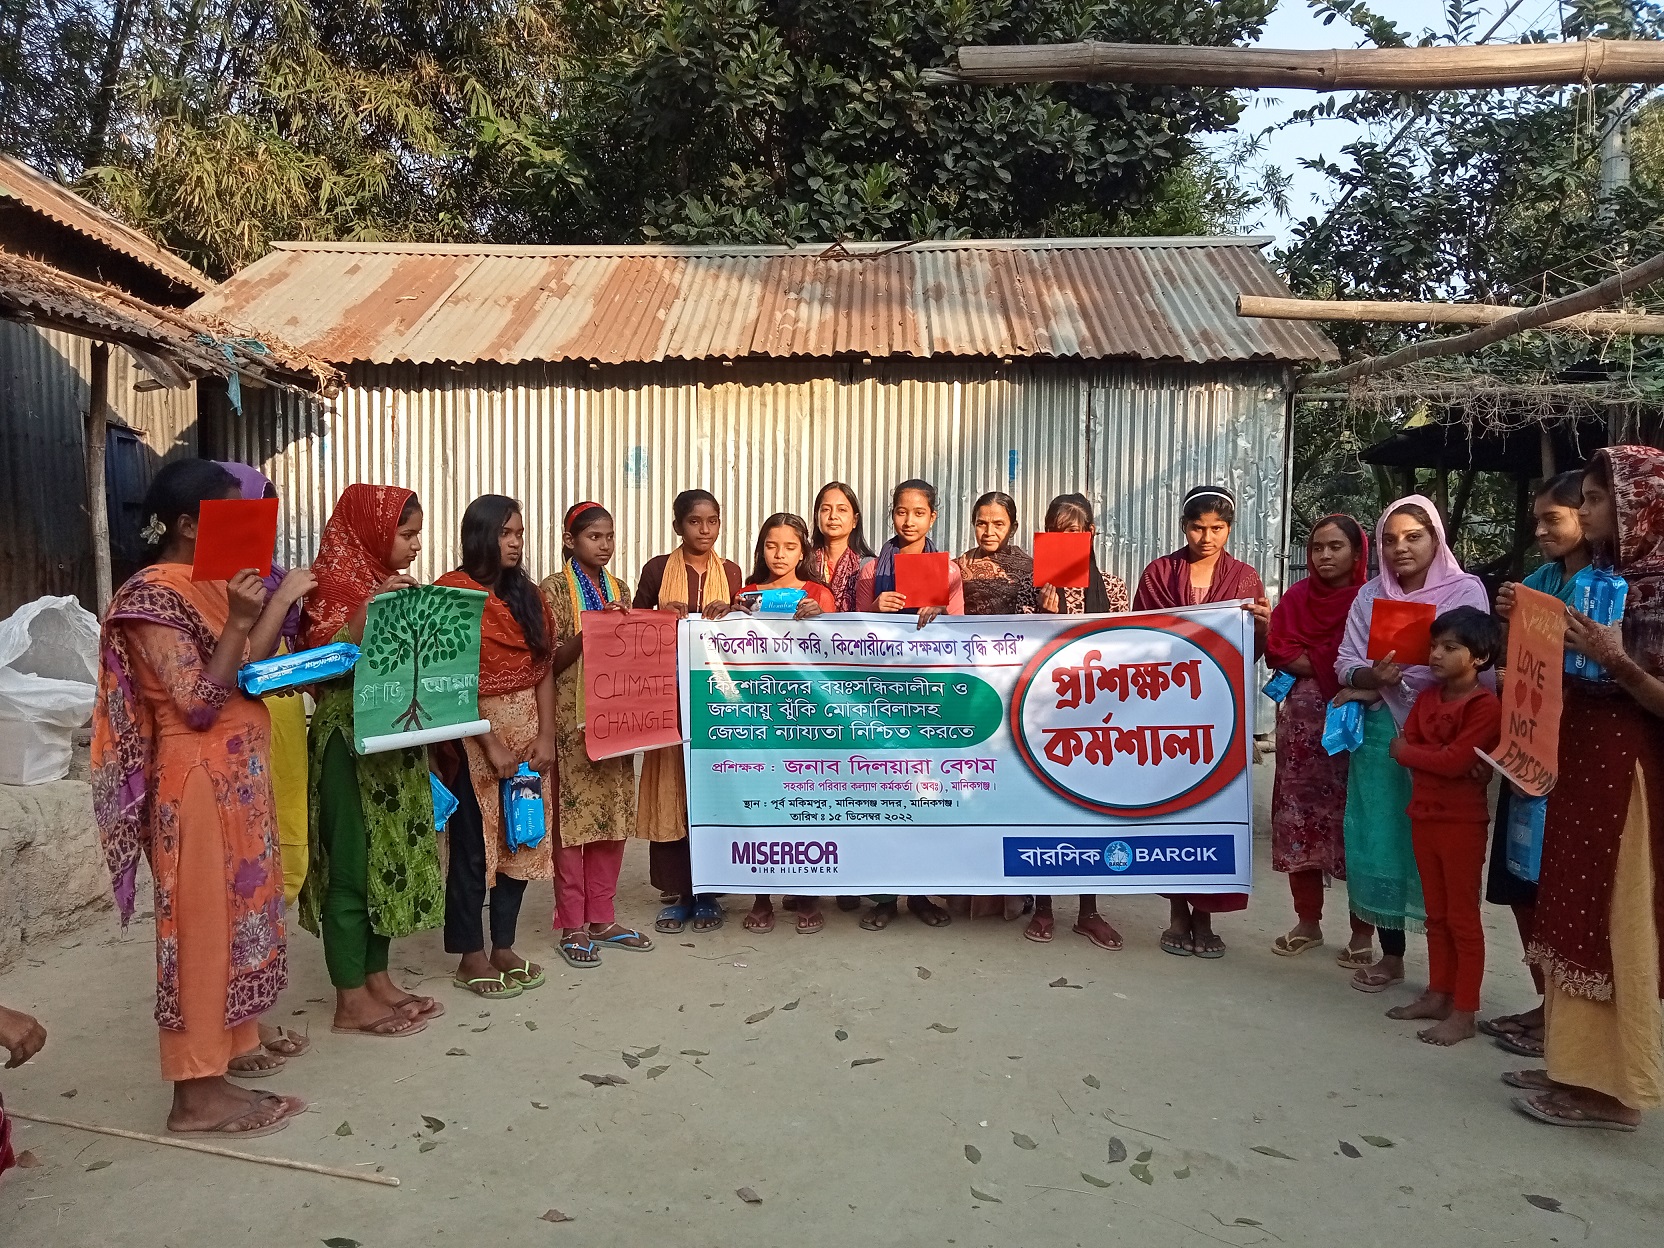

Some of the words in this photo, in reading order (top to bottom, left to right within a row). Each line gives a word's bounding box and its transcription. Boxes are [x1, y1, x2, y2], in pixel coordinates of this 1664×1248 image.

[604, 622, 676, 664] STOP
[772, 631, 794, 655] চর্চা
[831, 633, 903, 657] কিশোরীদের
[907, 639, 958, 656] সক্ষমতা
[961, 634, 988, 664] বৃদ্ধি
[1051, 650, 1202, 709] প্রশিক্ষণ
[1517, 645, 1546, 690] LOVE
[593, 671, 674, 699] CLIMATE
[707, 675, 812, 696] কিশোরীদের
[819, 676, 946, 697] বয়ঃসন্ধিকালীন
[952, 683, 968, 695] ও
[707, 702, 773, 720] জলবায়ু
[778, 698, 817, 721] ঝুঁকি
[823, 698, 942, 718] মোকাবিলাসহ
[593, 709, 674, 739] CHANGE
[708, 725, 768, 741] জেন্ডার
[774, 724, 844, 741] ন্যায্যতা
[849, 720, 912, 740] নিশ্চিত
[917, 725, 975, 739] করতে
[1042, 712, 1215, 767] কর্মশালা
[711, 760, 766, 774] প্রশিক্ষক
[783, 758, 841, 775] জনাব
[848, 755, 932, 775] দিলয়ারা
[940, 757, 998, 775] বেগম
[783, 778, 815, 792] সহকারি
[818, 778, 847, 792] পরিবার
[850, 781, 877, 792] কল্যাণ
[880, 779, 913, 792] কর্মকর্তা
[771, 796, 786, 810] পূর্ব
[835, 796, 878, 808] মানিকগঞ্জ
[790, 810, 818, 821] তারিখ
[846, 810, 880, 821] ডিসেম্বর
[884, 813, 914, 822] ২০২২
[731, 841, 839, 865] MISEREOR
[1017, 843, 1102, 867] বারসিক
[1135, 847, 1218, 862] BARCIK
